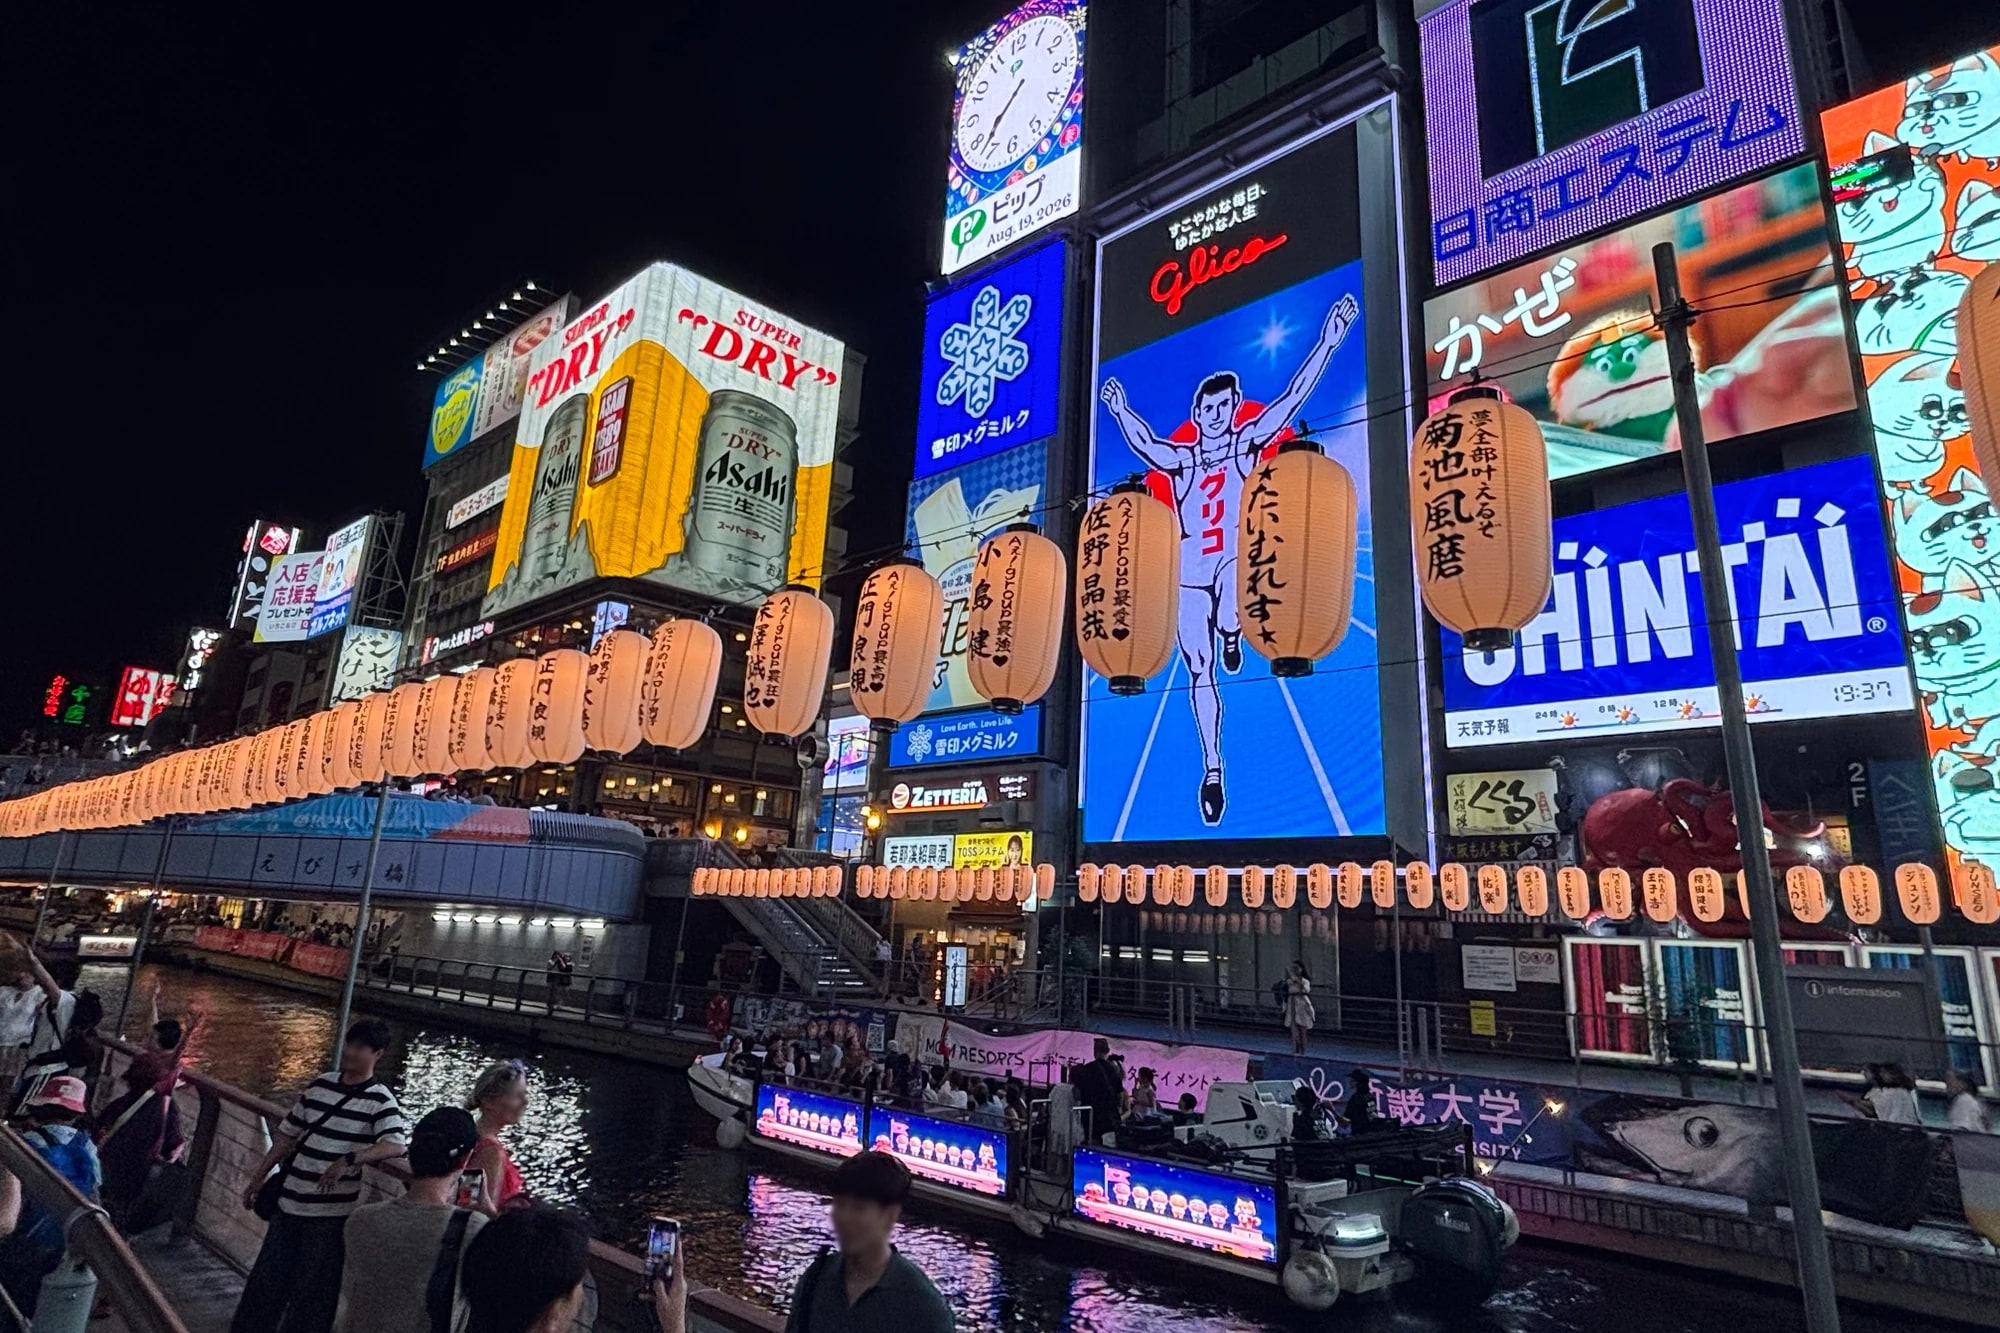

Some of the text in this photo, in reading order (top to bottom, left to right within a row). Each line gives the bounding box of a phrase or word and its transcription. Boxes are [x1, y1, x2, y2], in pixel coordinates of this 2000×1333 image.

[992, 174, 1046, 225] ピップ
[1435, 99, 1786, 262] 日商エステム
[987, 193, 1071, 248] Aug. 19, 2026
[1175, 204, 1258, 251] ゆたかな人生
[562, 303, 609, 349] SUPER
[733, 309, 803, 351] SUPER
[1433, 257, 1577, 380] かぜ
[739, 427, 769, 442] SUPER
[931, 409, 1030, 460] 雪印メグミルク
[533, 453, 579, 504] Asahi
[705, 450, 787, 506] Asahi
[1420, 412, 1474, 584] 菊池風磨
[1468, 409, 1502, 538] 夢全部叶えるぞ
[733, 497, 755, 516] 生
[1200, 466, 1227, 555] グリコ
[275, 563, 311, 584] 入店
[1081, 502, 1113, 642] 佐野晶哉
[1245, 483, 1287, 623] たいむれす
[271, 583, 319, 606] 応援金
[969, 540, 1001, 660] 小島健
[1462, 497, 1866, 687] HINTAI
[851, 574, 881, 694] 正門良規
[596, 635, 618, 684] なにわ男子
[530, 657, 557, 742] 正門良規
[1834, 680, 1892, 703] 19:37
[935, 731, 1019, 757] 雪印メグミルク
[941, 715, 1013, 733] Love Earth. Love Life.
[1457, 718, 1510, 737] 天気予報
[911, 787, 988, 807] ZETTERIA
[1468, 779, 1536, 825] くくる
[259, 853, 404, 883] えびす橋
[1827, 986, 1901, 999] information
[959, 1046, 1026, 1066] RESORTS
